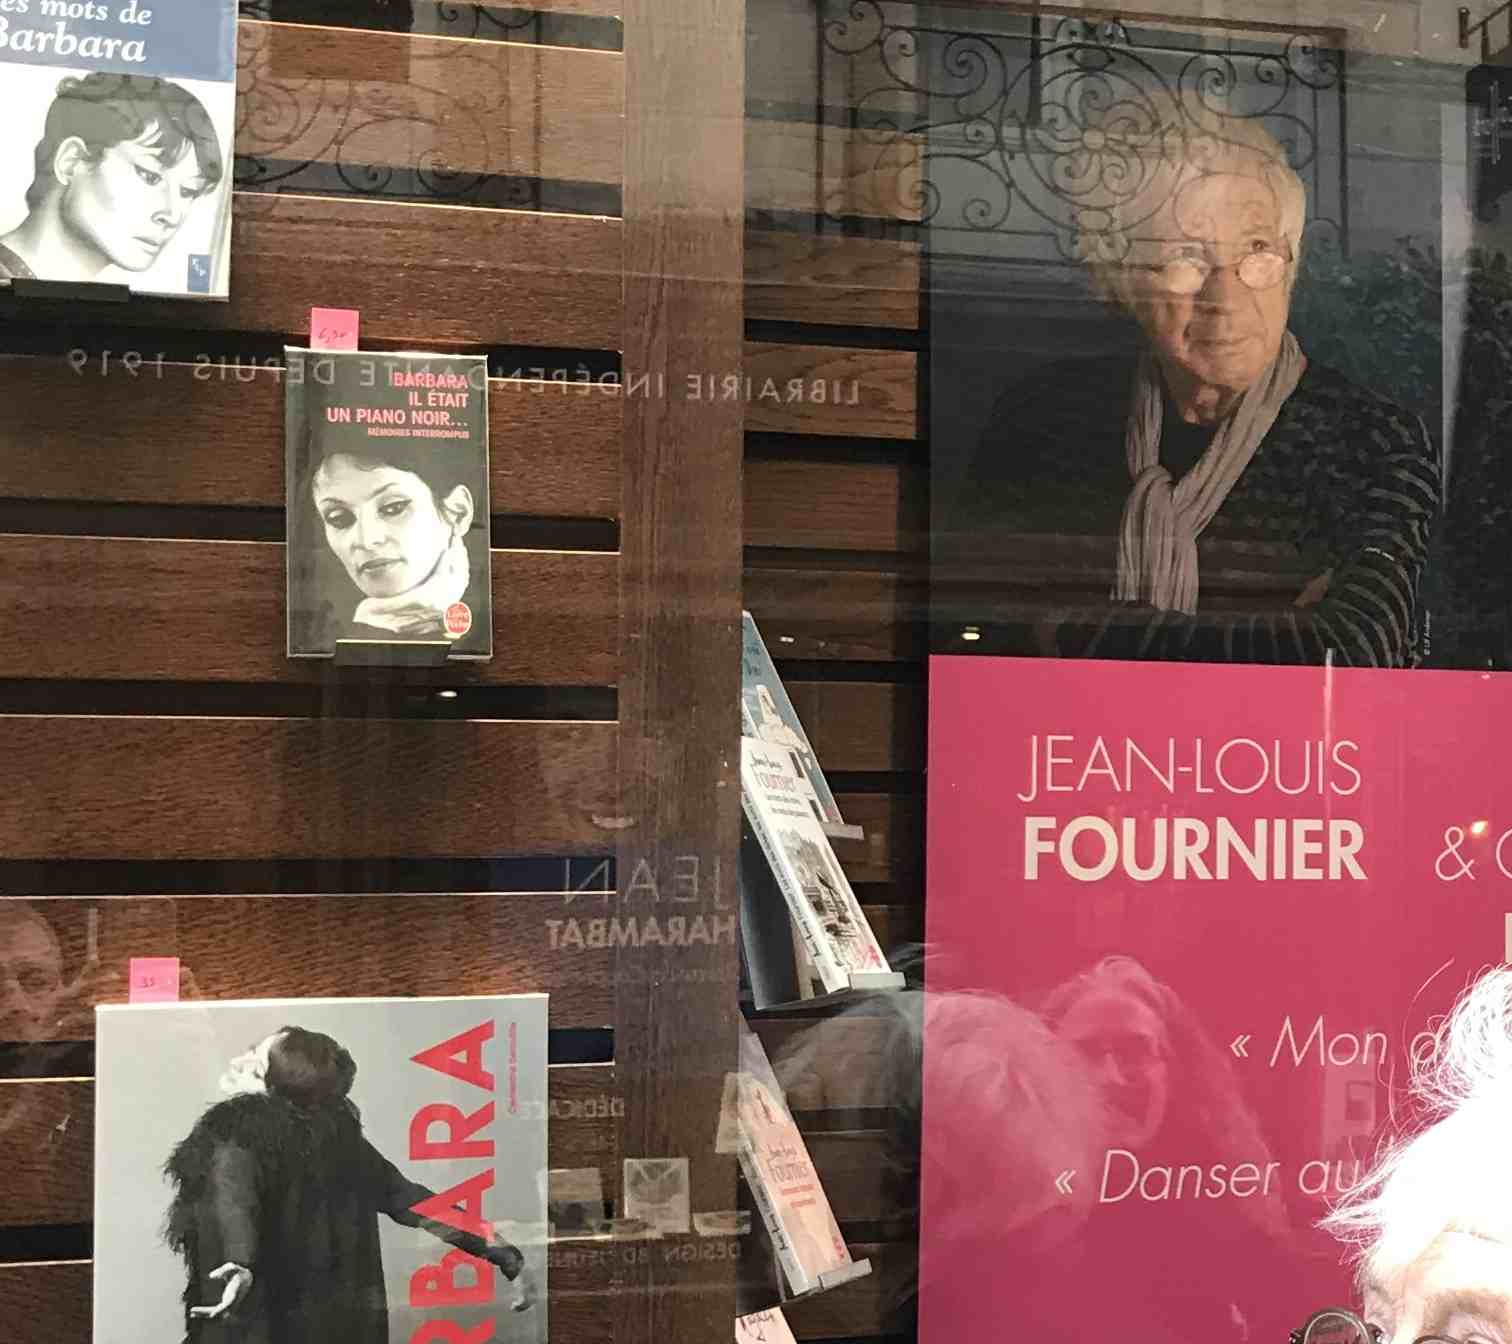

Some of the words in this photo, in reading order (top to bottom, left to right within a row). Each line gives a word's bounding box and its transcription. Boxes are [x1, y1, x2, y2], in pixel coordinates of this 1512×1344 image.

[119, 0, 152, 25] de
[0, 15, 147, 62] Barbara
[394, 372, 469, 389] BARBARA
[409, 391, 422, 406] IL
[428, 389, 469, 407] ÉTAIT
[326, 407, 350, 422] UN
[356, 408, 405, 425] PIANO
[1016, 735, 1361, 802] JEAN-LOUIS
[1024, 815, 1368, 881] FOURNIER
[1435, 826, 1476, 881] &
[1270, 1016, 1387, 1068] Mon
[1100, 1149, 1281, 1203] Danser
[1299, 1158, 1360, 1194] au
